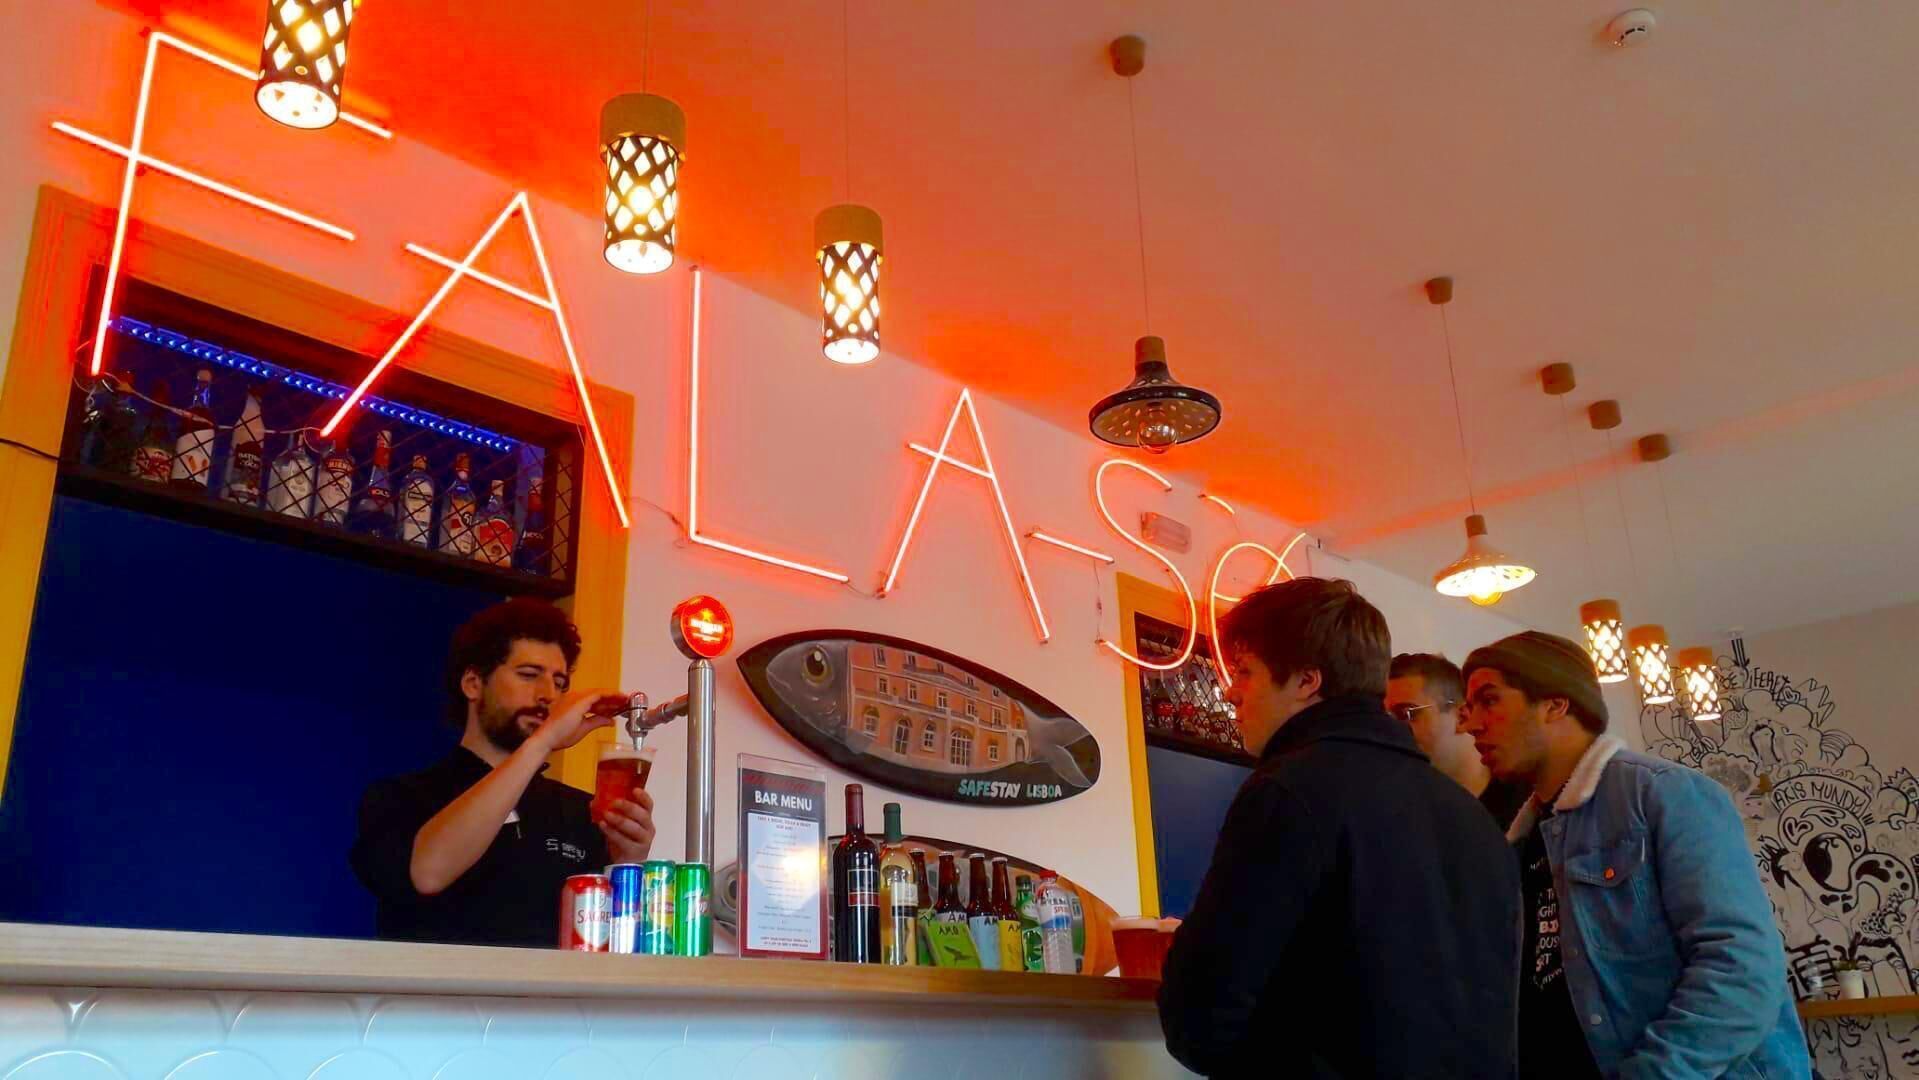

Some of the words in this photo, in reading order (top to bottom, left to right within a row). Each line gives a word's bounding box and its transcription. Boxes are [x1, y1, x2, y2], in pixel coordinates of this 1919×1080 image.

[958, 779, 1021, 798] SAFESTAY
[1026, 783, 1063, 798] LISBOA
[754, 790, 779, 807] BAR
[780, 794, 813, 812] MENU
